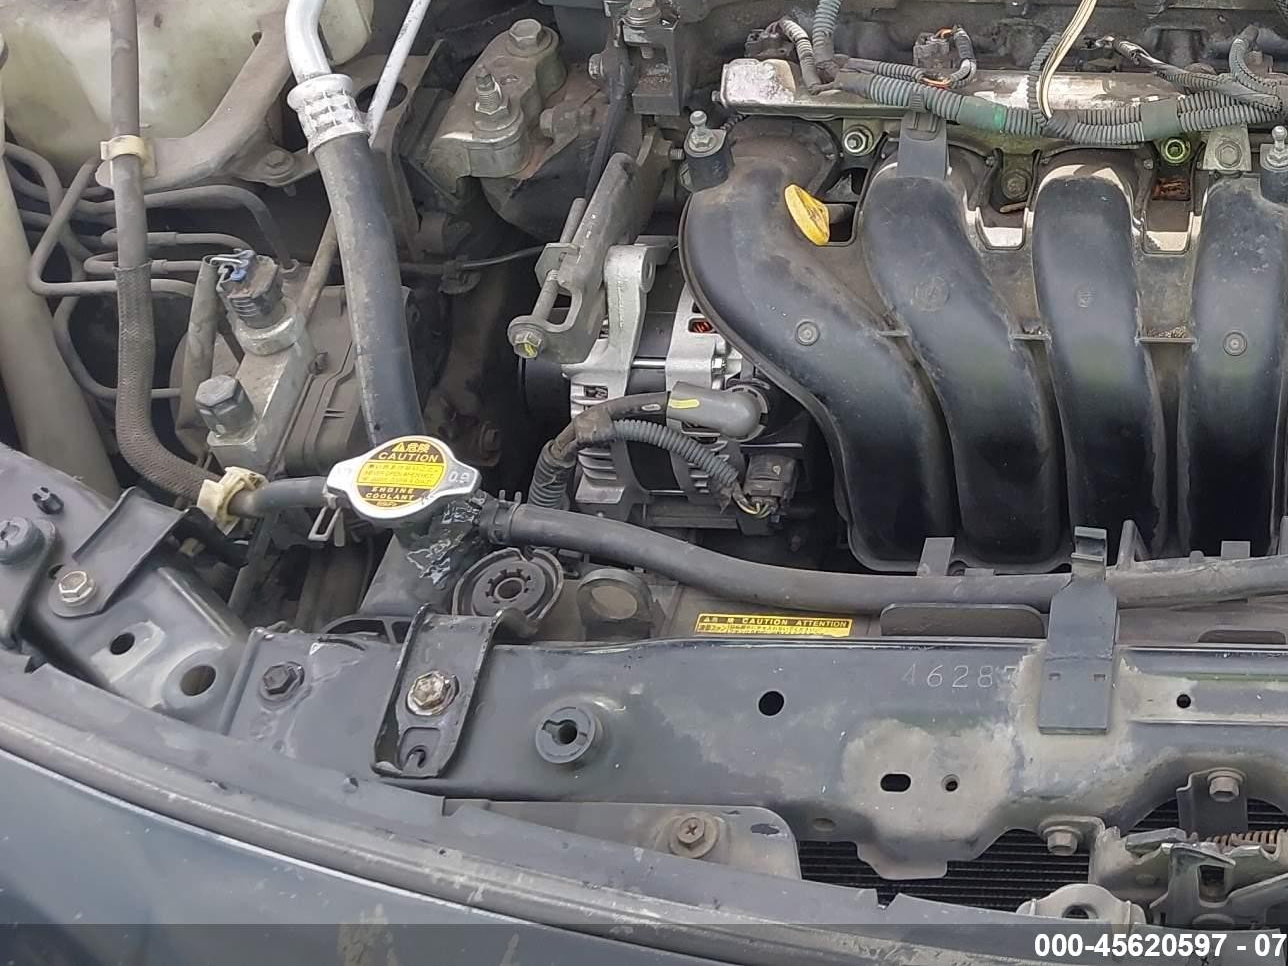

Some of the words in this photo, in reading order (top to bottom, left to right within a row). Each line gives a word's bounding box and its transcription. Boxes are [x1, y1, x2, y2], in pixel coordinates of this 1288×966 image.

[378, 451, 440, 463] CAUTION
[448, 470, 470, 484] 0.9
[371, 486, 415, 494] ENGINE
[365, 492, 416, 501] COOLANT
[742, 617, 788, 626] CAUTION
[796, 620, 848, 628] ATTENTION
